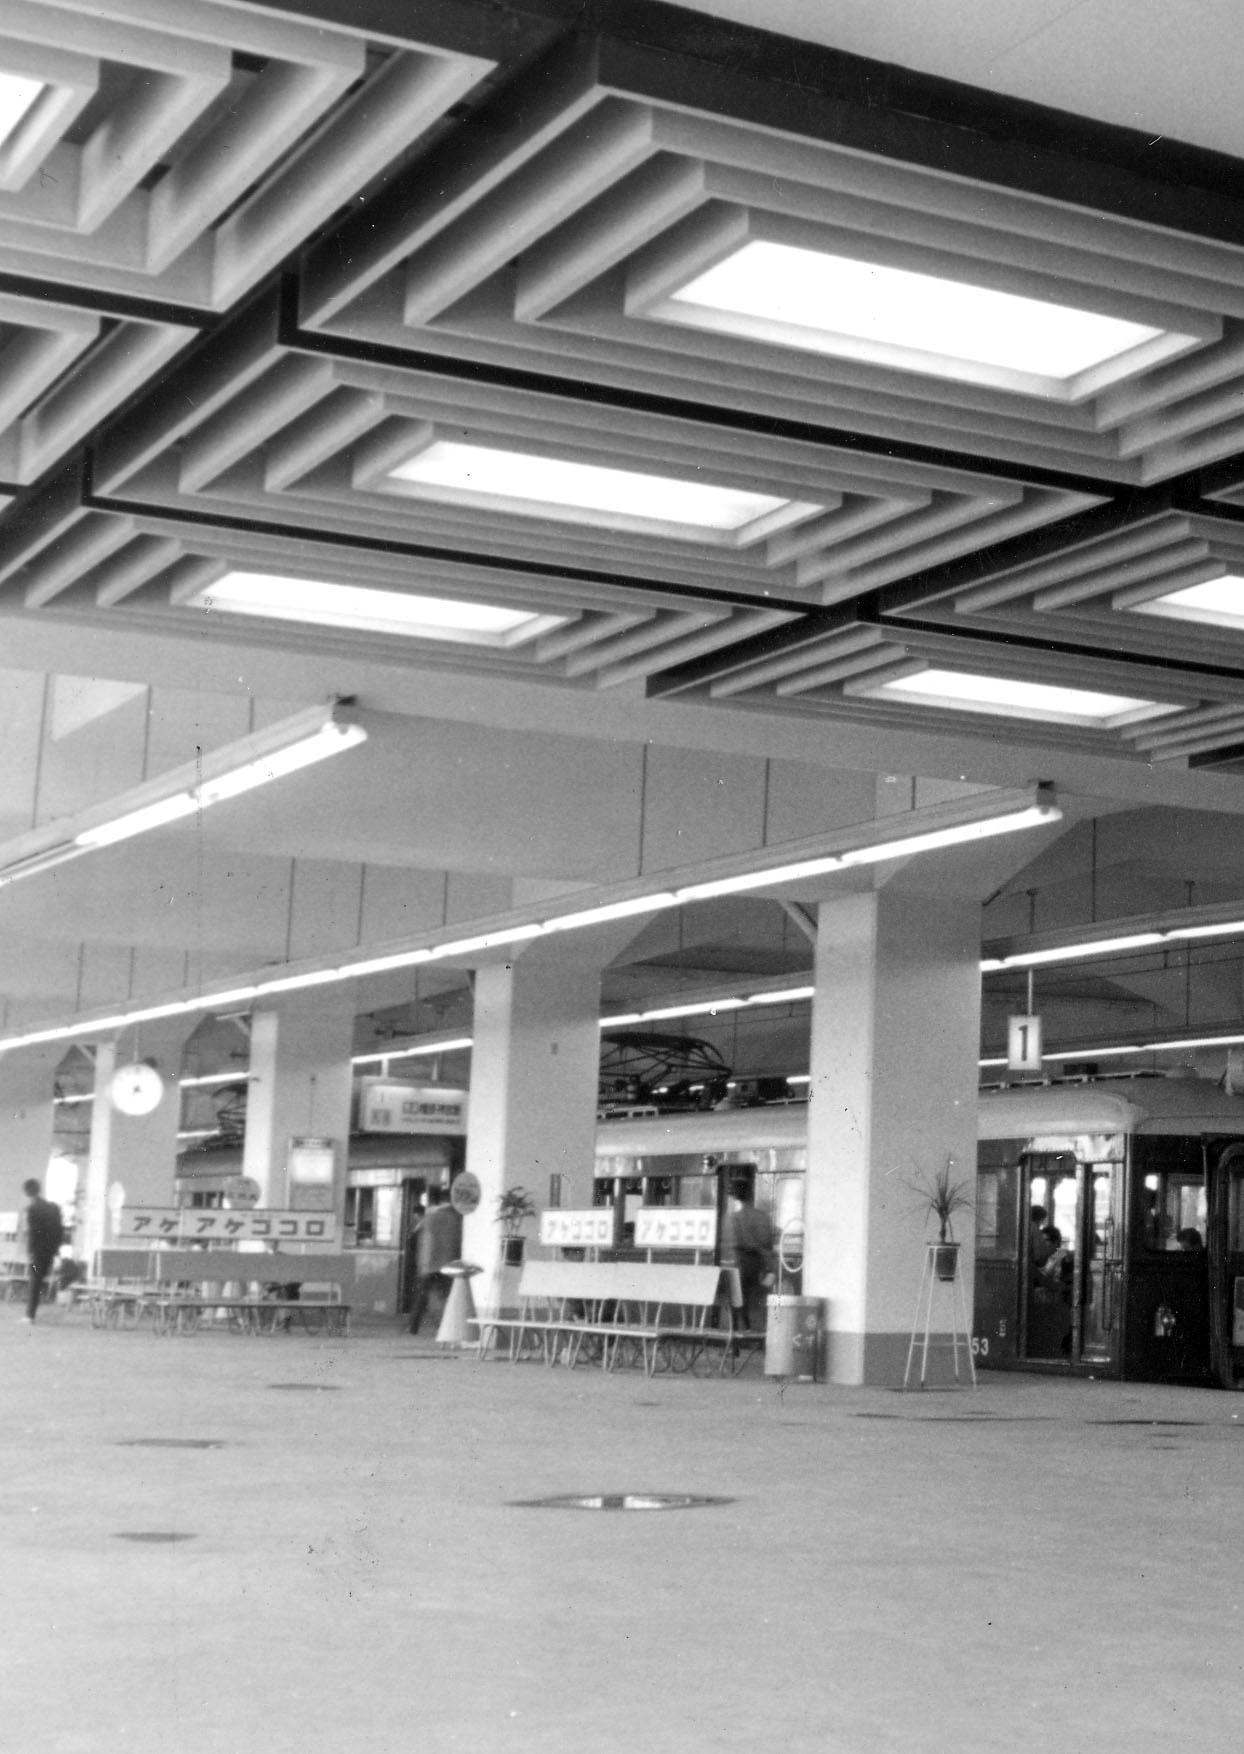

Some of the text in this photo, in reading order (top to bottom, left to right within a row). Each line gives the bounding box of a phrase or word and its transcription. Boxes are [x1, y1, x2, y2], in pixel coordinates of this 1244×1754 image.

[1018, 1024, 1028, 1062] 1
[196, 1217, 325, 1237] アケココロ
[547, 1219, 608, 1240] アケココロ
[641, 1219, 710, 1241] アケココロ
